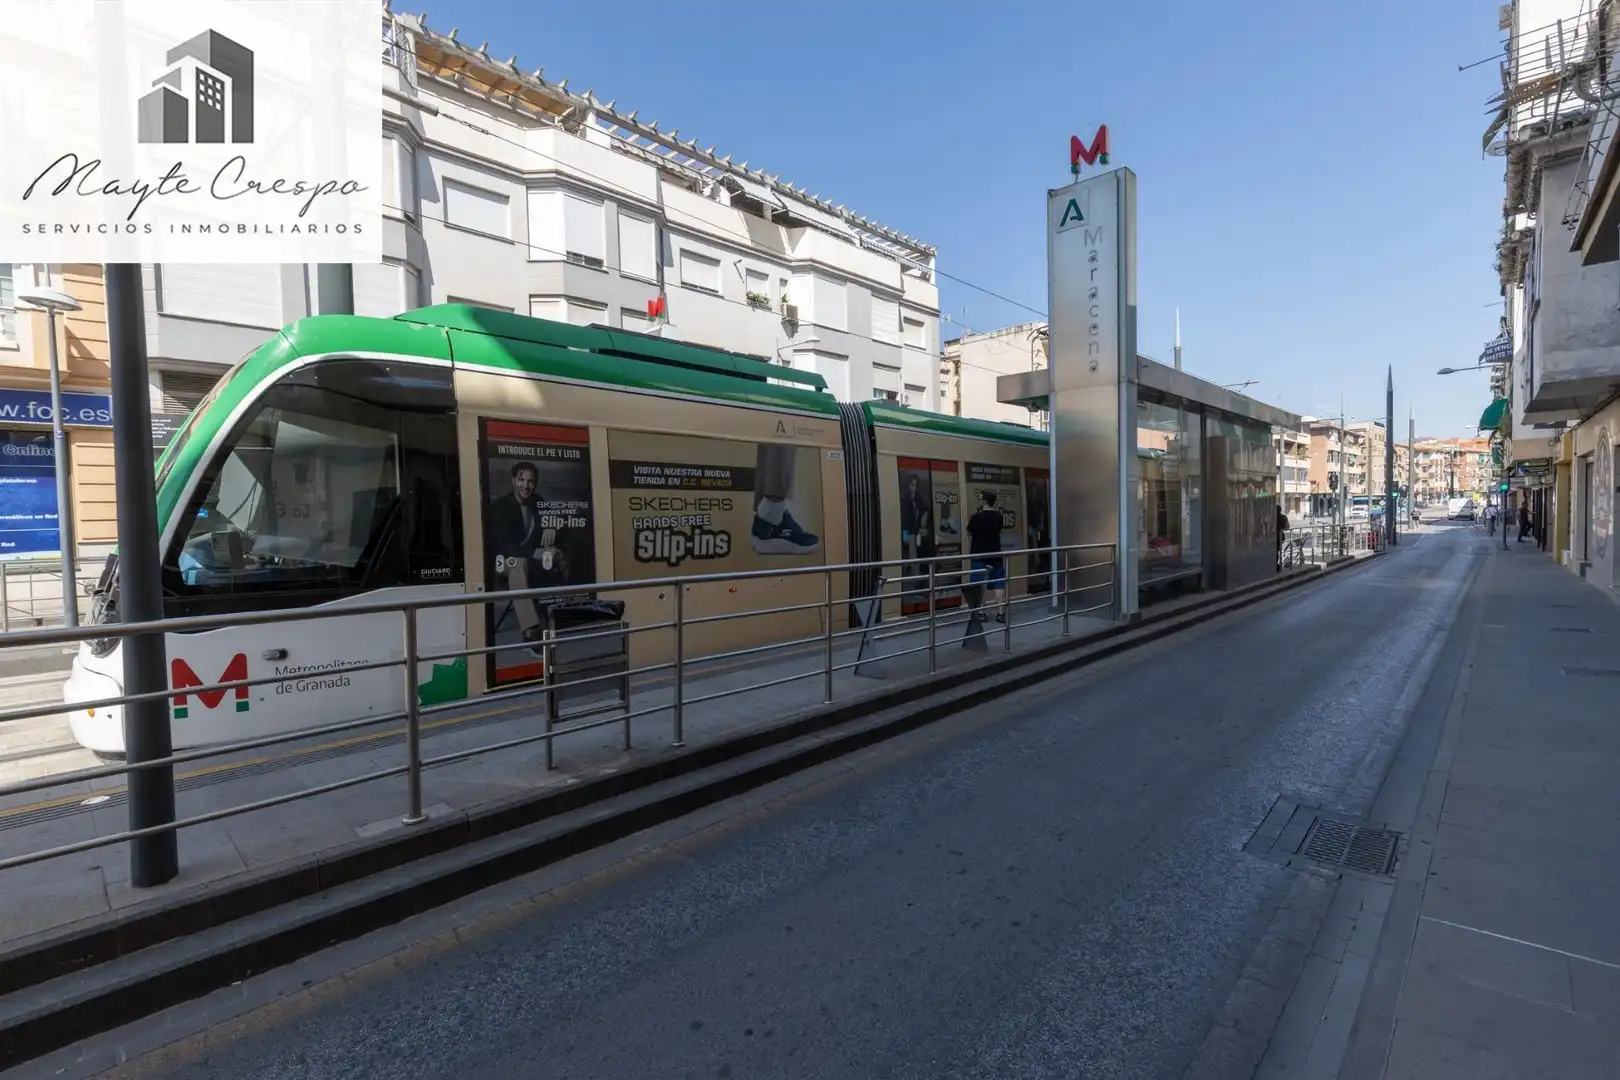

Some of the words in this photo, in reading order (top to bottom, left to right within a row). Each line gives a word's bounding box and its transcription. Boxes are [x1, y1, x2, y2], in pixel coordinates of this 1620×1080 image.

[1083, 226, 1104, 374] Maracena
[498, 445, 535, 456] INTRODUCE
[537, 447, 545, 457] EL
[546, 448, 556, 457] PIE
[558, 448, 562, 457] Y
[563, 449, 580, 458] LISTO
[633, 465, 662, 475] VISITA
[663, 467, 702, 477] NUESTRA
[704, 469, 731, 478] NUEVA
[633, 476, 665, 485] TIENDA
[667, 477, 680, 485] EN
[700, 478, 733, 487] NEVADA
[536, 501, 588, 509] SKECHERS
[628, 496, 733, 511] SKECHERS
[541, 515, 587, 530] Slip-ins
[633, 516, 678, 529] HANDS
[681, 515, 711, 526] FREE
[636, 527, 730, 564] Slip-ins
[276, 680, 292, 695] de
[296, 676, 350, 692] Granada
